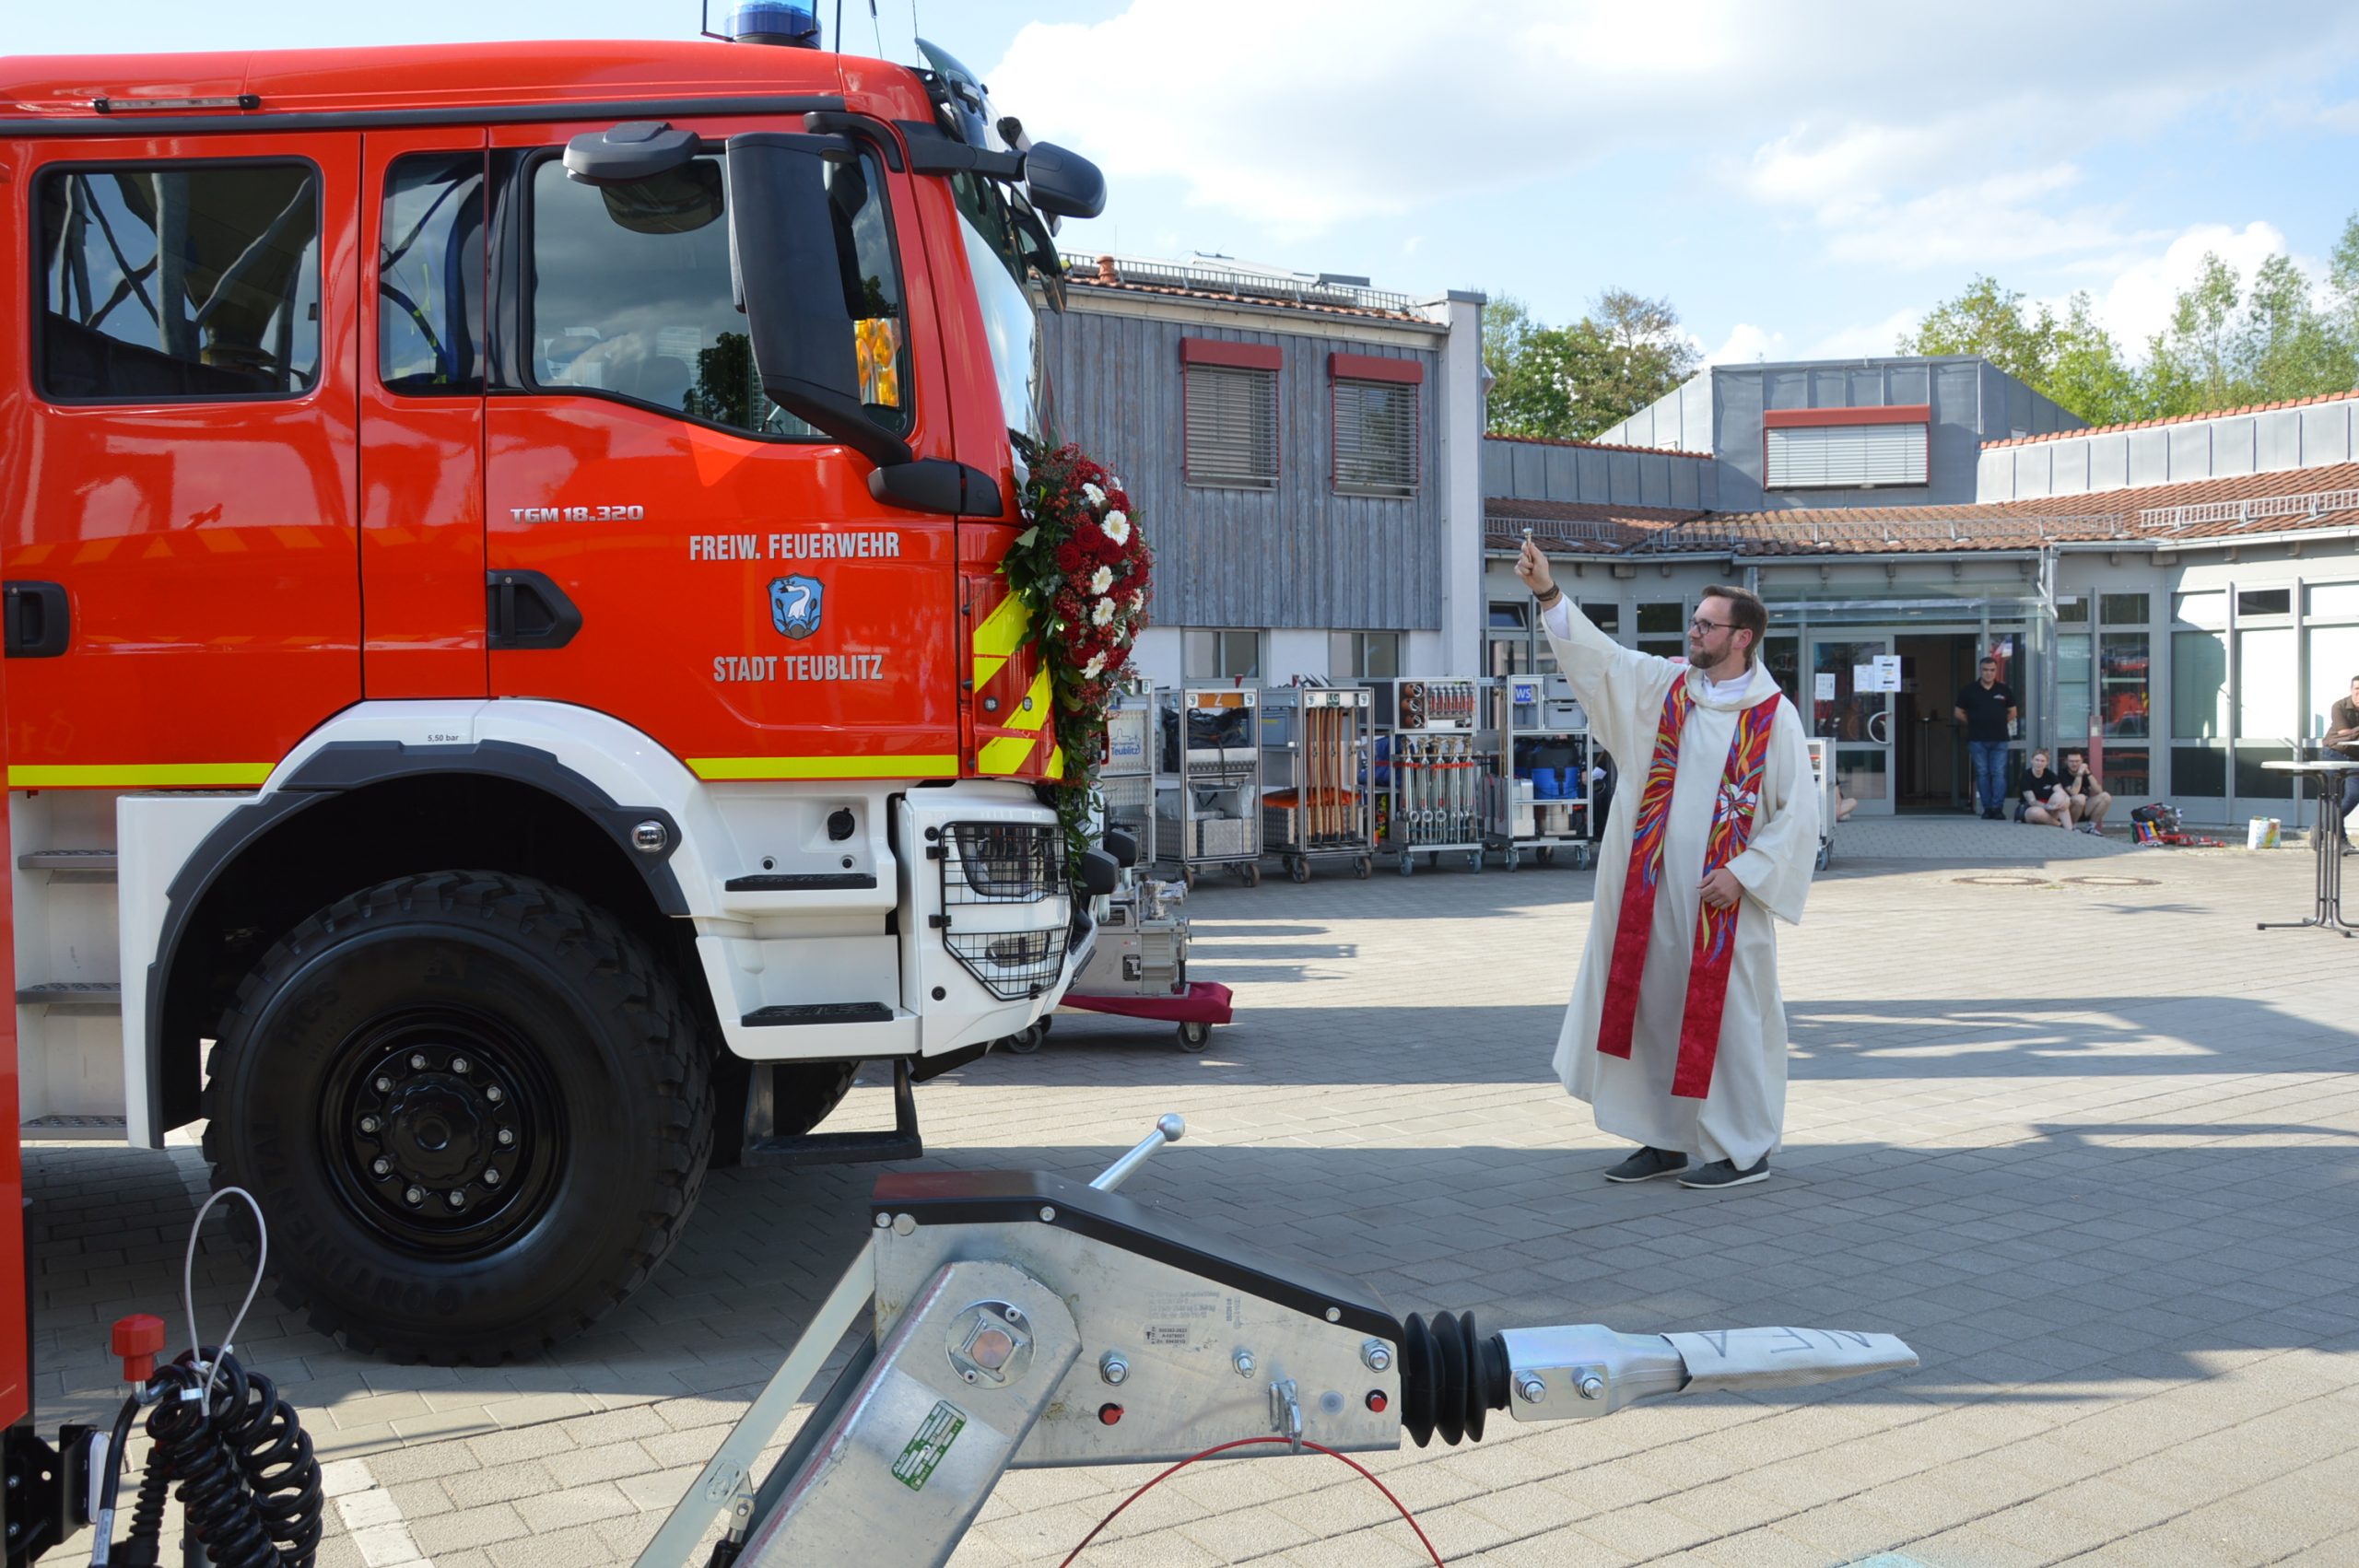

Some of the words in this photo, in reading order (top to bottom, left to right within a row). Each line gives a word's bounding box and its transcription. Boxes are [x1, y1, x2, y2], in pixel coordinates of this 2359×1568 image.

[510, 508, 558, 523] TGM
[562, 505, 644, 522] 18.320
[689, 534, 761, 561] FREIW.
[768, 532, 899, 559] FEUERWEHR
[713, 656, 777, 682] STADT
[784, 654, 883, 681] TEUBLITZ
[1214, 693, 1223, 707] Z
[1327, 694, 1340, 703] LG
[1516, 688, 1532, 699] WS
[428, 734, 444, 743] 5,50
